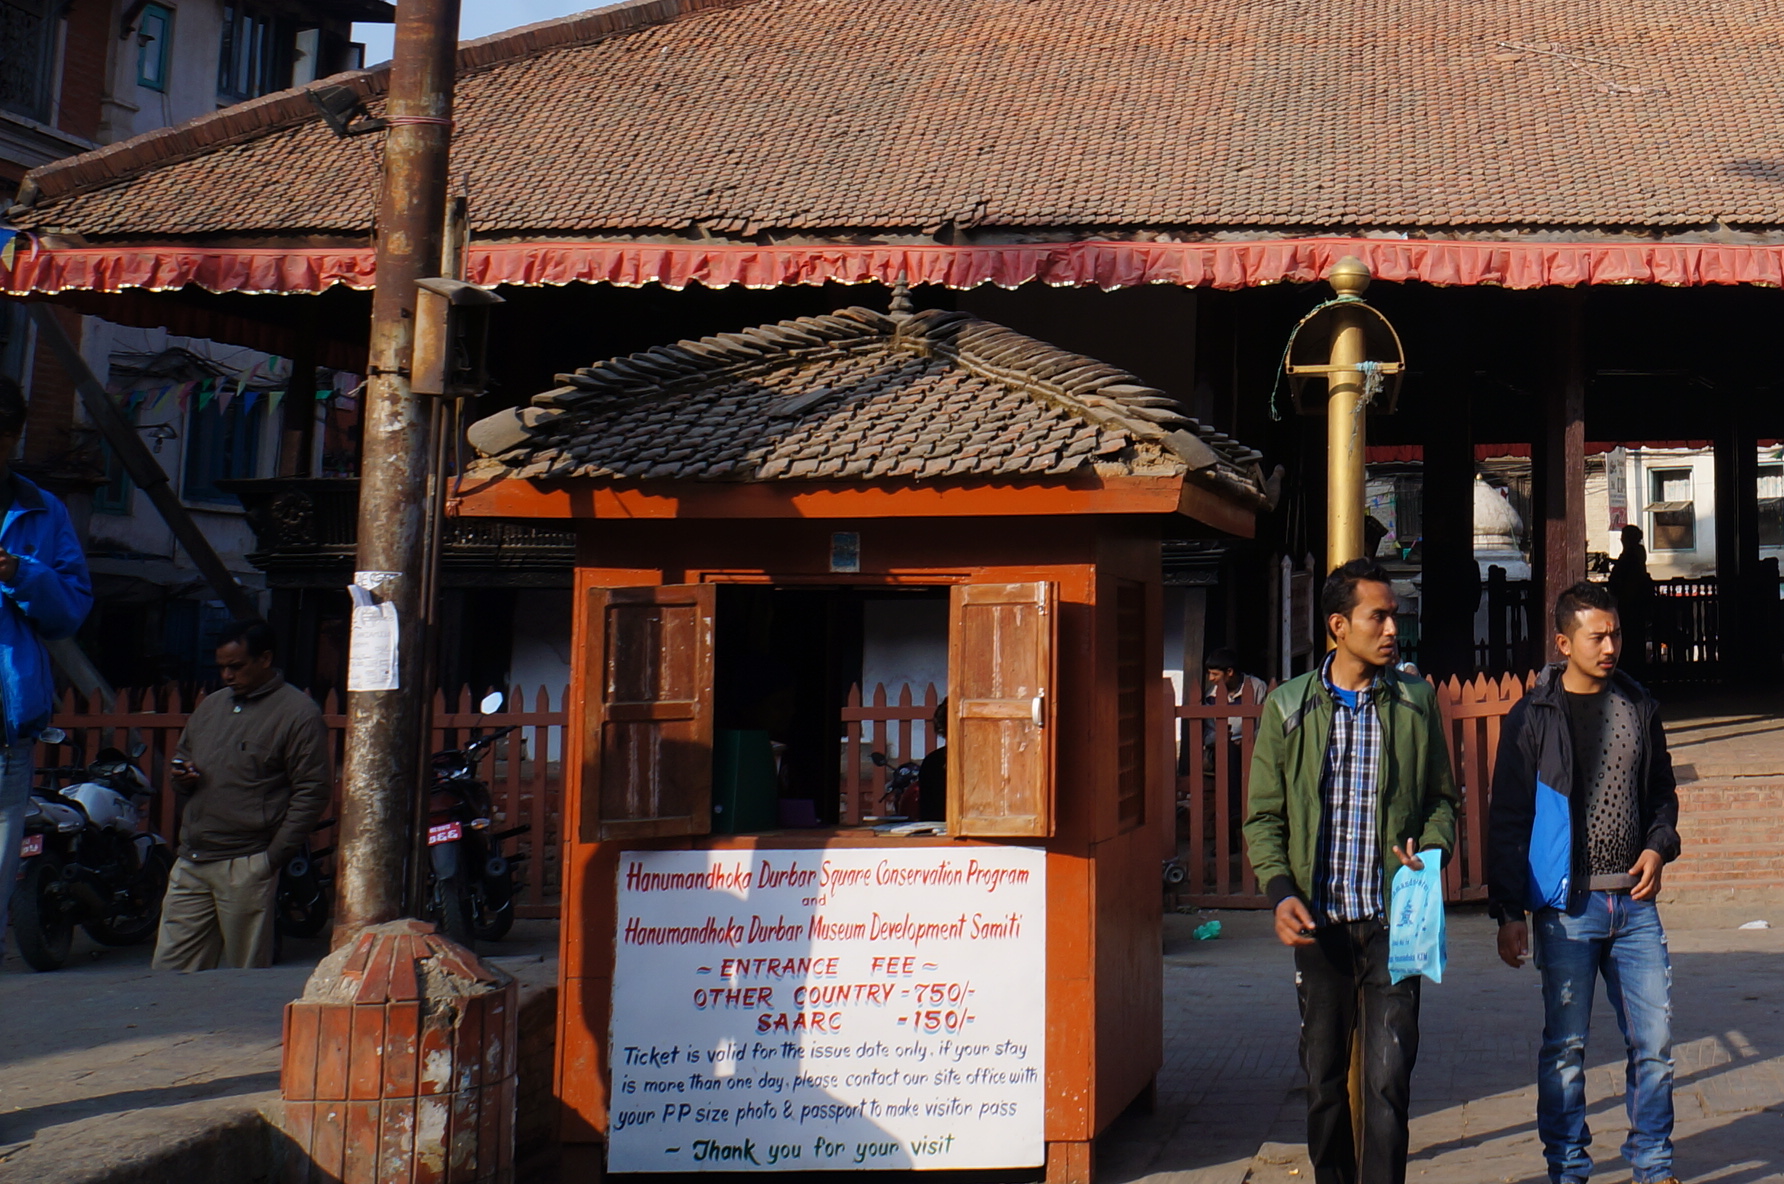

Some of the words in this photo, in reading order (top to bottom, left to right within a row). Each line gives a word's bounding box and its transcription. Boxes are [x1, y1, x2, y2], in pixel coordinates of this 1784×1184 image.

[626, 861, 752, 892] Hanumandhoka
[757, 860, 816, 889] Durbar
[820, 860, 871, 897] Square
[876, 859, 962, 886] Conservation
[966, 859, 1030, 893] Program
[802, 894, 826, 906] and
[625, 916, 744, 948] Hanumandhoka
[748, 915, 803, 944] Durbar
[808, 914, 866, 941] Museum
[869, 912, 967, 948] Development
[970, 912, 1023, 940] Samiti
[719, 957, 840, 978] ENTRANCE
[871, 956, 916, 975] FEE
[693, 985, 774, 1008] OTHER
[793, 982, 896, 1006] COUNTRY
[755, 1011, 842, 1034] SAARC
[624, 1045, 680, 1067] Ticket
[687, 1044, 700, 1064] is
[707, 1043, 747, 1064] valid
[752, 1042, 777, 1060] for
[780, 1041, 805, 1060] the
[810, 1041, 851, 1058] issue
[856, 1041, 889, 1058] date
[938, 1040, 952, 1056] if
[955, 1044, 990, 1062] your
[995, 1039, 1028, 1059] stay
[621, 1074, 637, 1094] is
[644, 1080, 685, 1093] more
[689, 1073, 721, 1090] than
[727, 1078, 752, 1090] one
[793, 1069, 838, 1093] please
[845, 1068, 899, 1086] contact
[903, 1073, 928, 1086] our
[934, 1068, 961, 1086] site
[966, 1067, 1006, 1084] office
[1009, 1066, 1038, 1084] with
[613, 1109, 655, 1131] your
[695, 1101, 729, 1122] size
[735, 1099, 777, 1126] photo
[783, 1099, 795, 1120] &
[800, 1098, 867, 1125] passport
[869, 1097, 882, 1117] to
[885, 1097, 919, 1118] make
[925, 1096, 973, 1116] visitor
[978, 1099, 1018, 1120] pass
[692, 1137, 761, 1166] Thank
[766, 1144, 802, 1165] you
[814, 1136, 845, 1158] for
[852, 1142, 900, 1164] your
[911, 1133, 955, 1156] visit
